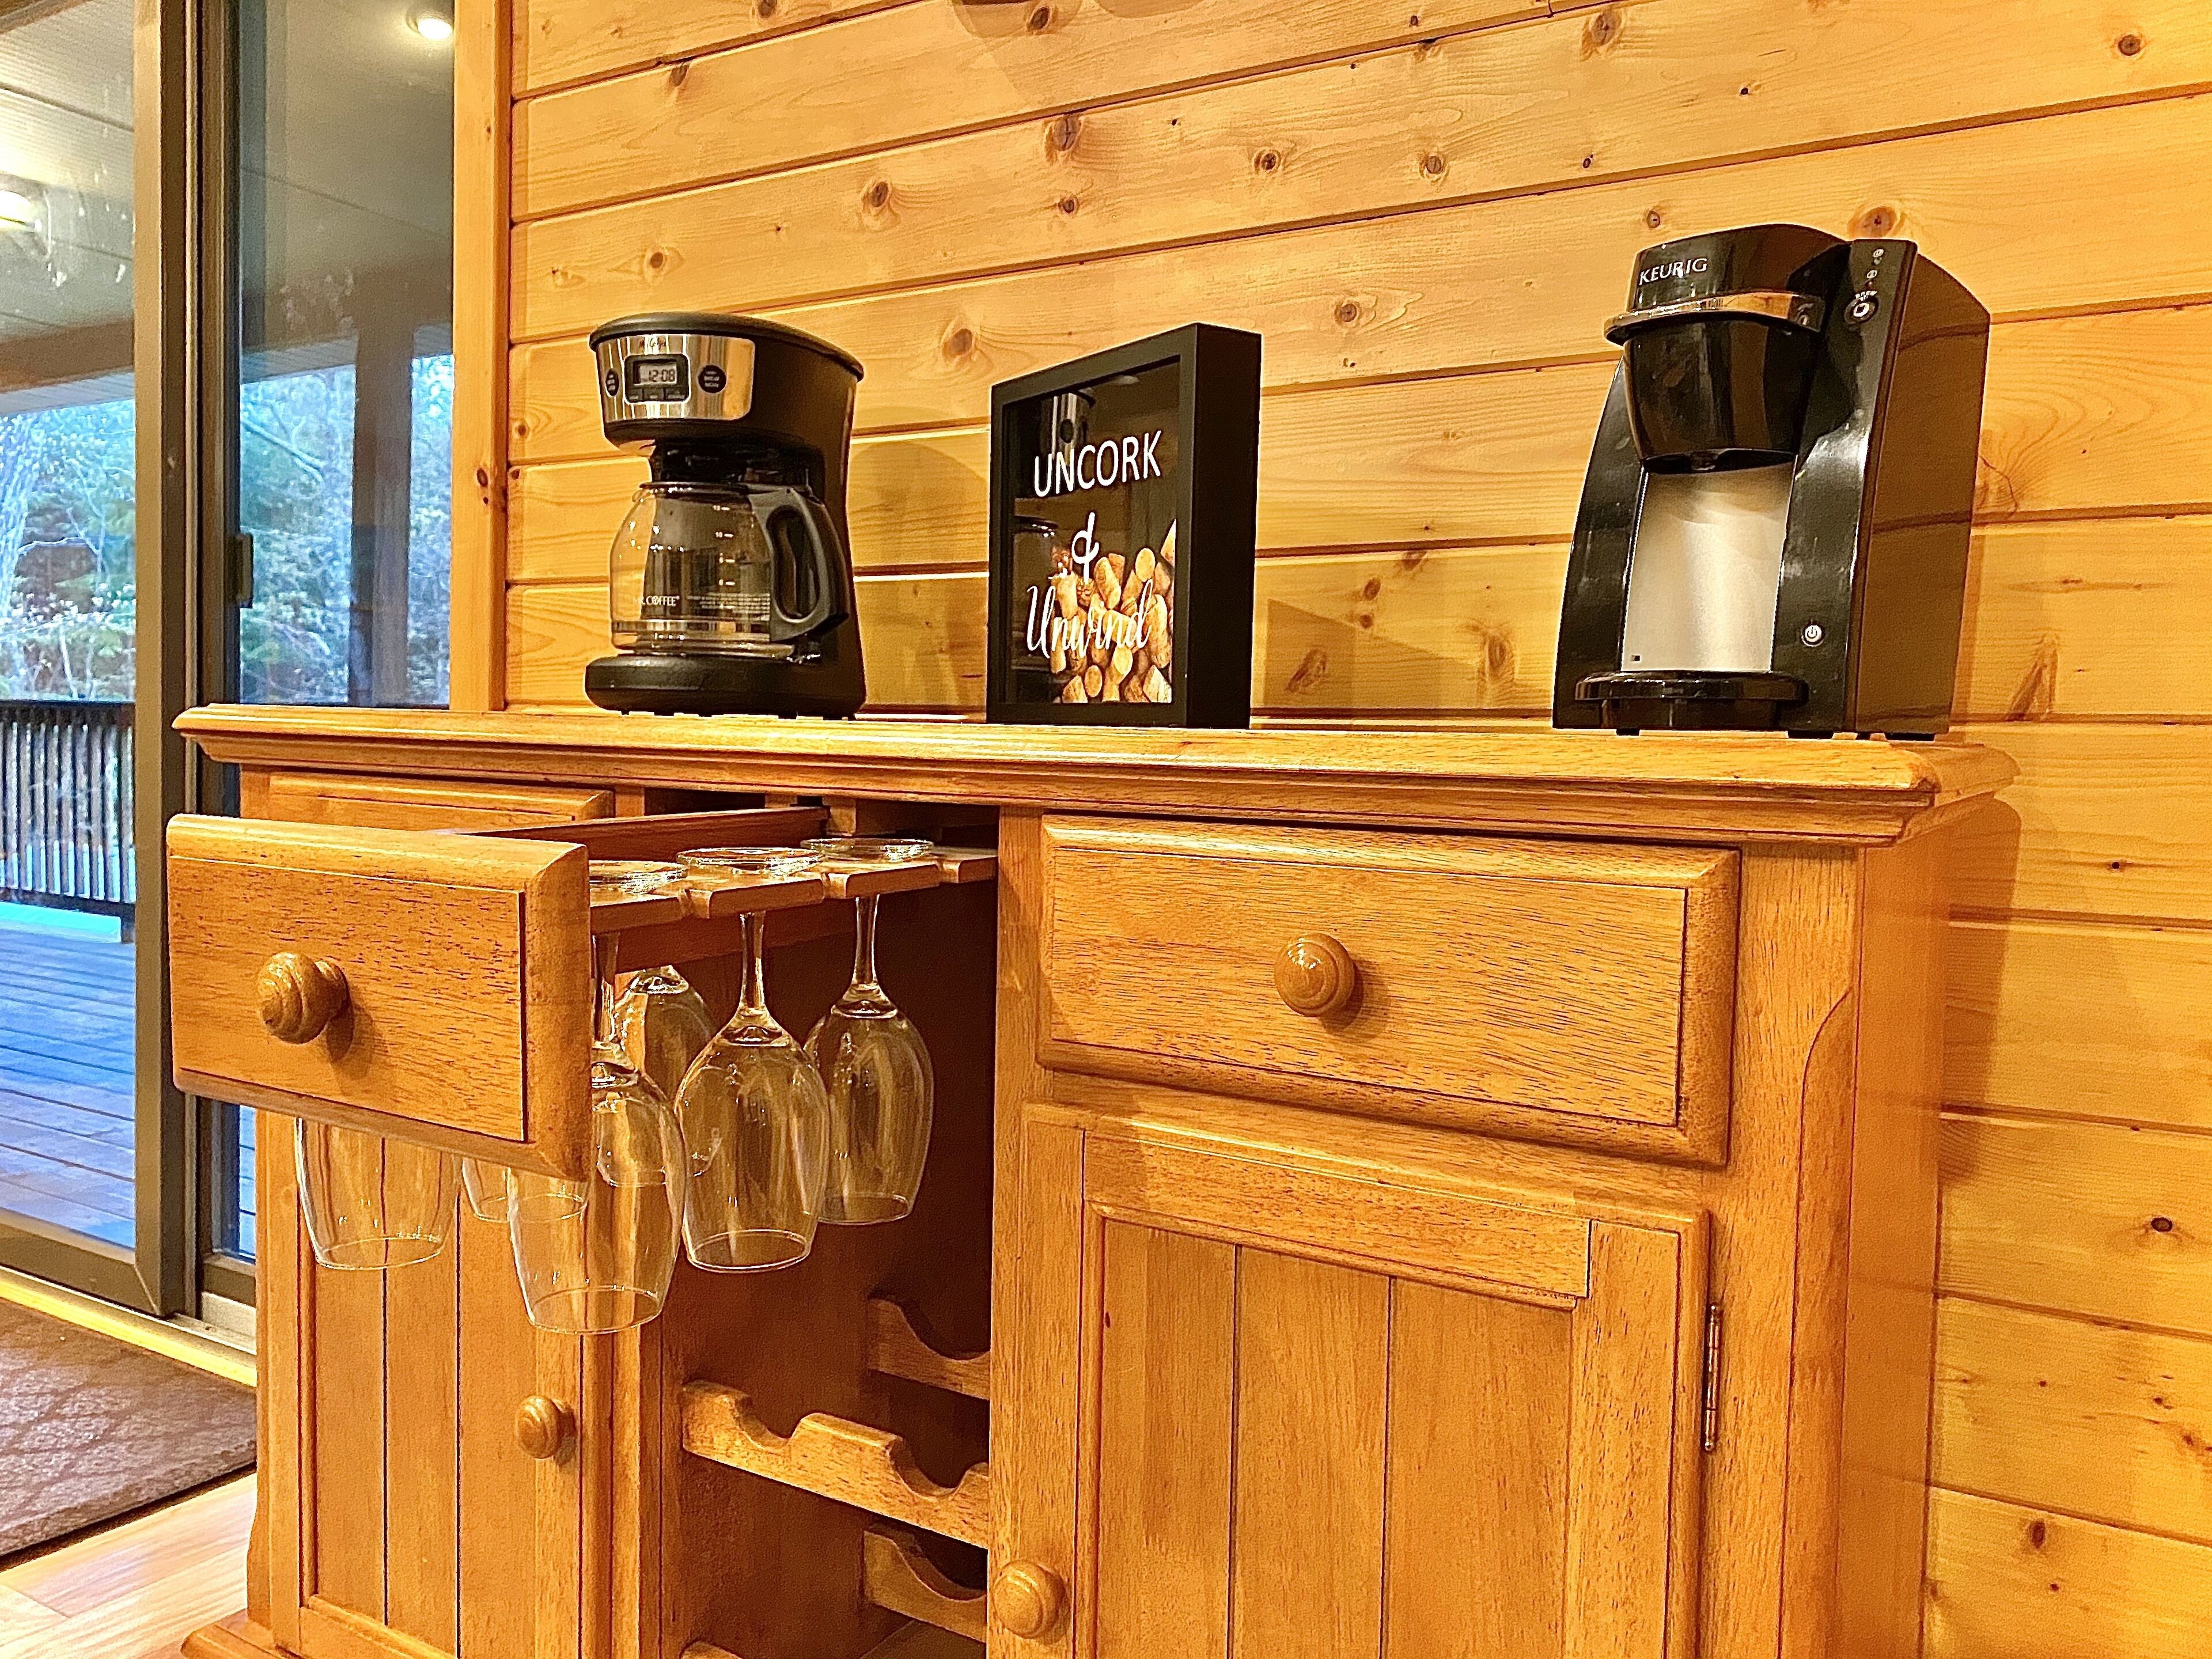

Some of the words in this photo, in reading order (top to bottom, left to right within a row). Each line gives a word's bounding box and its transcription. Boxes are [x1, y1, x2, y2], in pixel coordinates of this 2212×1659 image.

[1639, 257, 1707, 286] KEURIG
[648, 369, 676, 382] 12:08
[1035, 430, 1162, 497] UNCORK
[1027, 579, 1153, 659] Unwind
